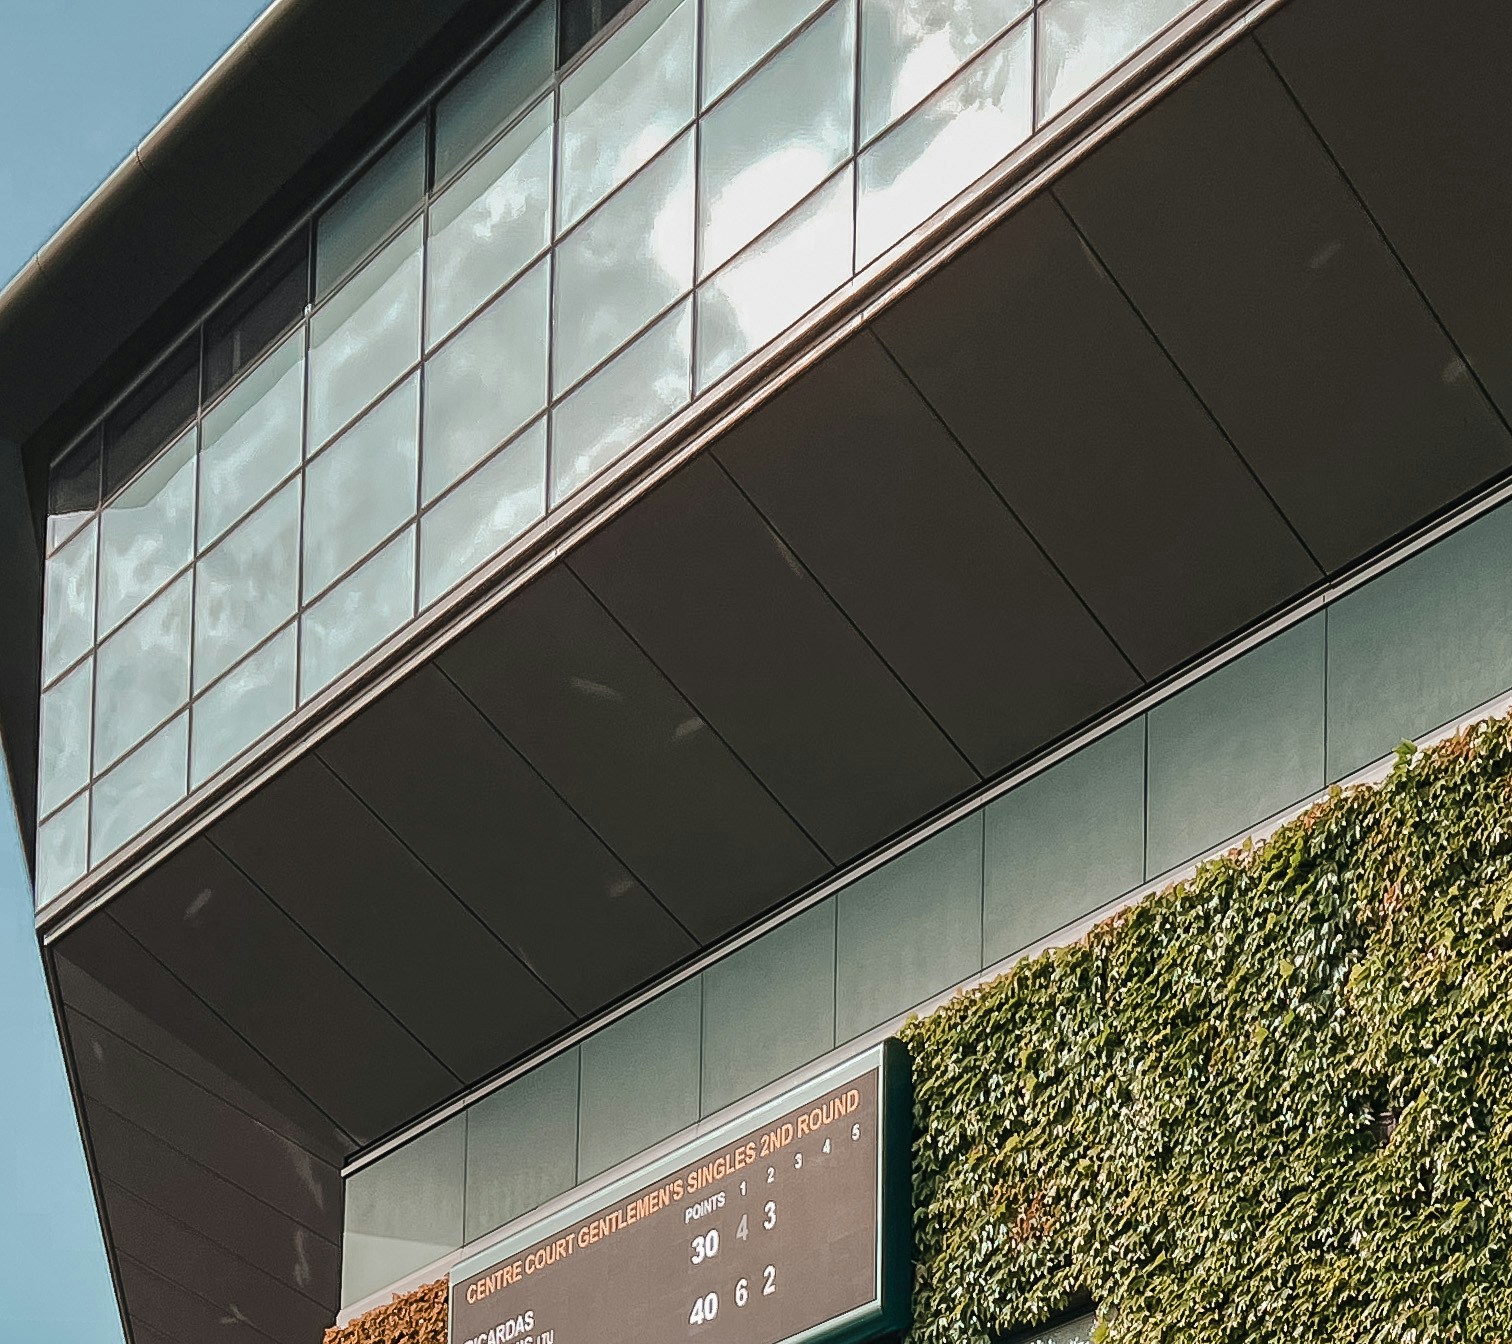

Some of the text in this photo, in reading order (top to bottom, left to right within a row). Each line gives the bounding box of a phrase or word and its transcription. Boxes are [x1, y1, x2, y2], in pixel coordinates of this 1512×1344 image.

[740, 1124, 859, 1195] 1 2 3 4 5
[467, 1090, 858, 1303] CENTRE COURT GENTLEMEN'S SINGLES 2ND ROUND
[686, 1192, 725, 1223] POINTS
[692, 1202, 776, 1264] 30 4 3
[690, 1266, 775, 1324] 40 6 2
